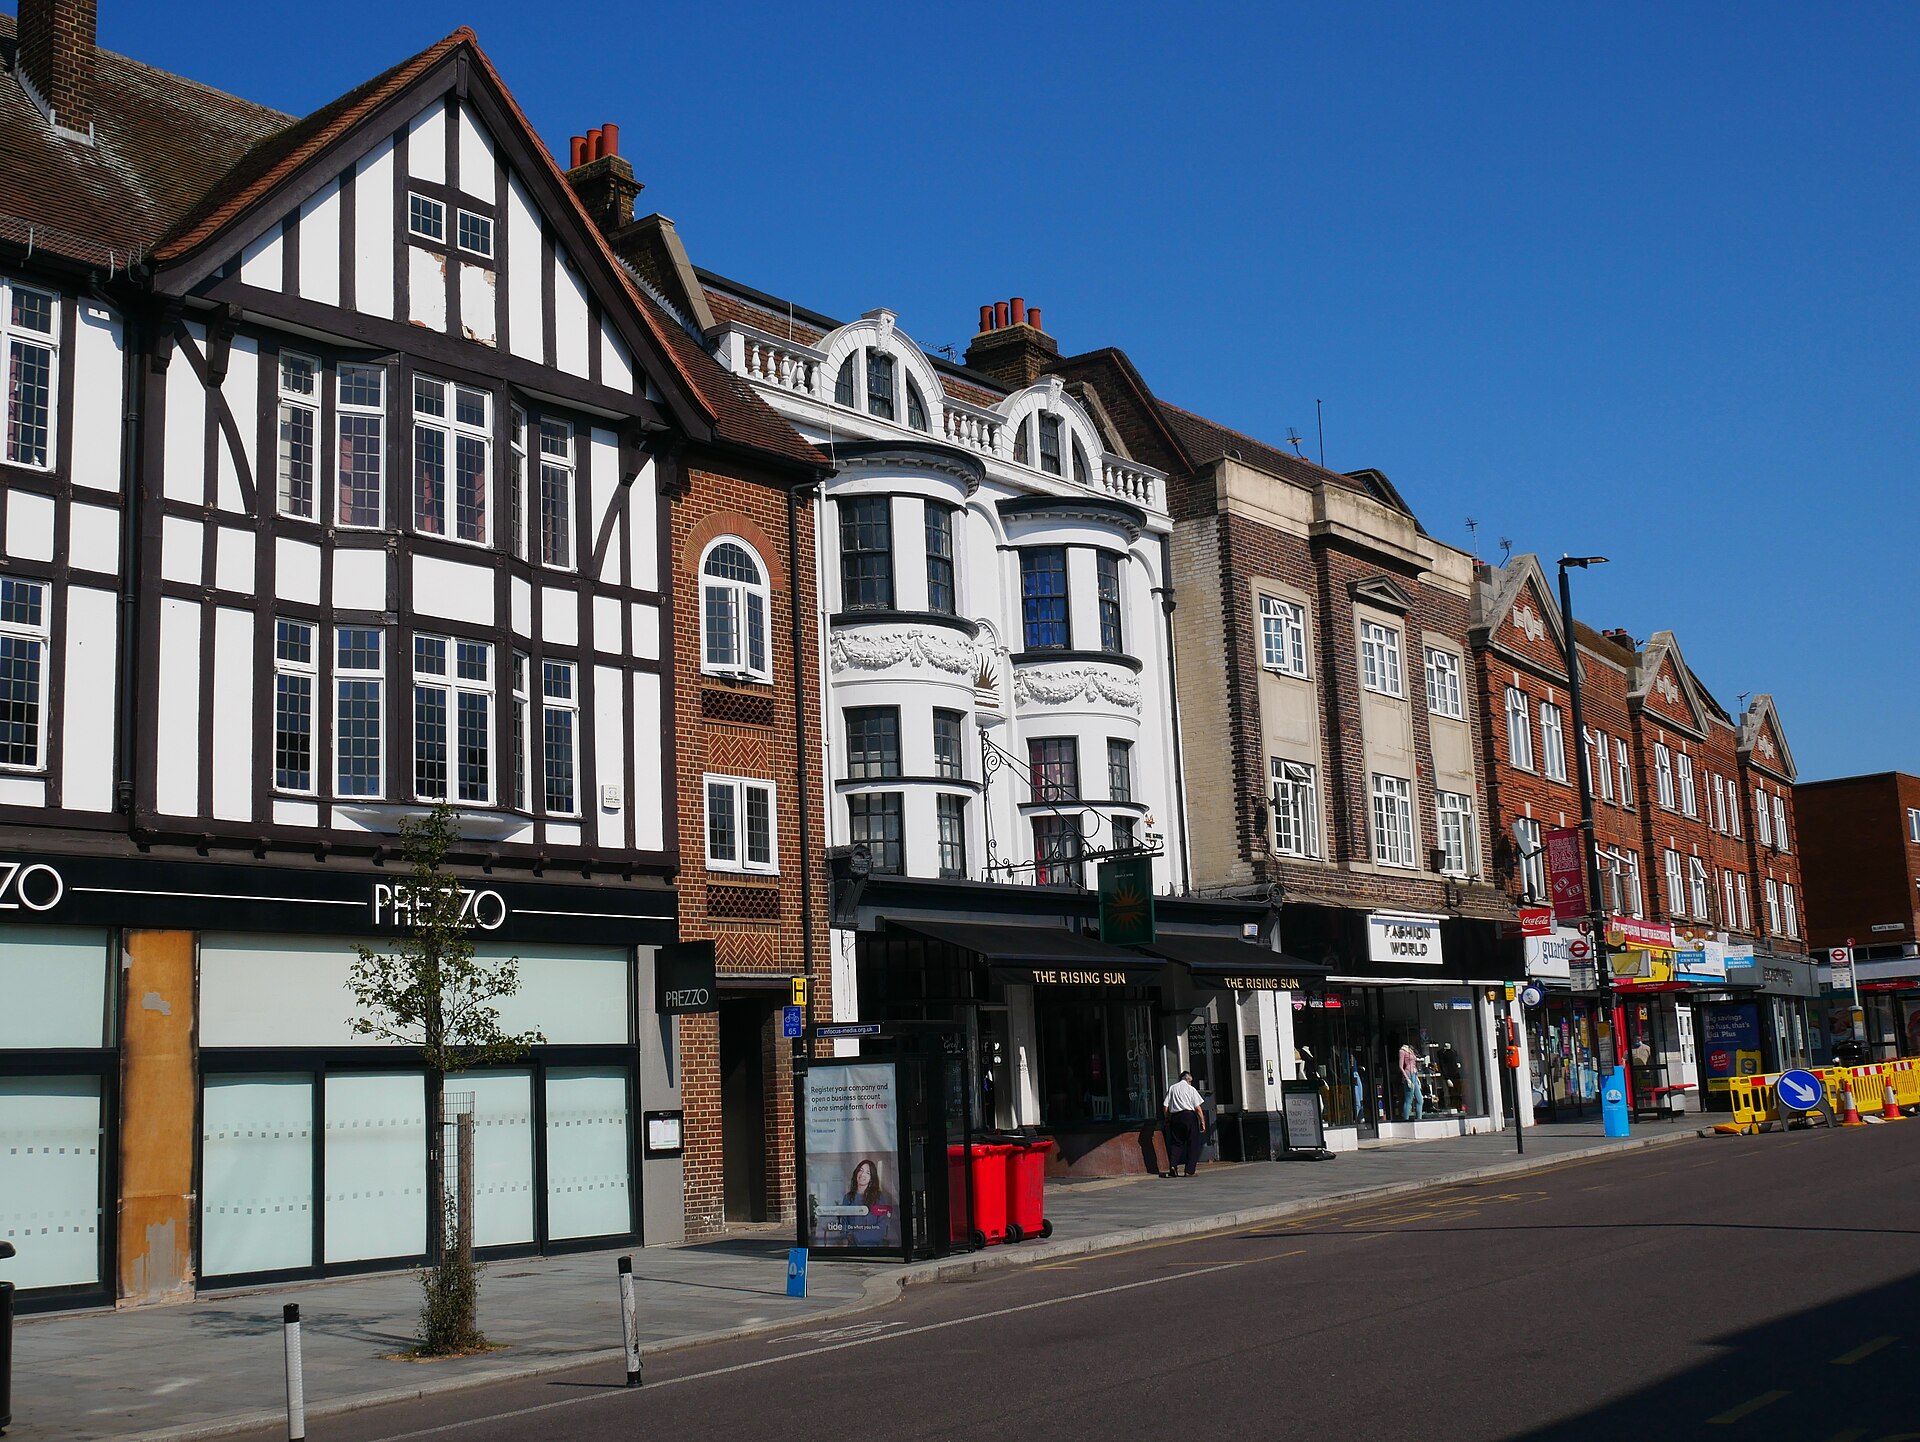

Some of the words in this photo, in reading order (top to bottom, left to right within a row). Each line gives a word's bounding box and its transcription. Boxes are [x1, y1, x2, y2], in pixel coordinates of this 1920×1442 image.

[1550, 850, 1578, 862] PAY
[1384, 924, 1432, 941] FASHION
[1846, 938, 1853, 946] S
[1390, 941, 1429, 957] WORLD
[1542, 938, 1569, 964] guardi
[1032, 970, 1057, 983] THE
[1060, 971, 1101, 984] RISING
[1103, 972, 1127, 985] SUN
[1224, 977, 1244, 989] THE
[1246, 978, 1278, 989] RISING
[1280, 978, 1300, 989] SUN
[793, 980, 806, 1002] H
[665, 988, 709, 1008] PREZZO
[1705, 1015, 1717, 1023] Big
[1717, 1014, 1742, 1022] savings
[823, 1026, 873, 1035] infocus-media.org.uk
[1731, 1021, 1750, 1029] that's
[811, 1086, 834, 1095] Register
[835, 1085, 848, 1093] your
[848, 1084, 876, 1092] company
[831, 1094, 857, 1102] business
[857, 1093, 881, 1101] account
[829, 1104, 849, 1113] simple
[848, 1103, 865, 1111] form,
[865, 1102, 875, 1110] for
[875, 1101, 888, 1109] free
[827, 1222, 843, 1231] tide
